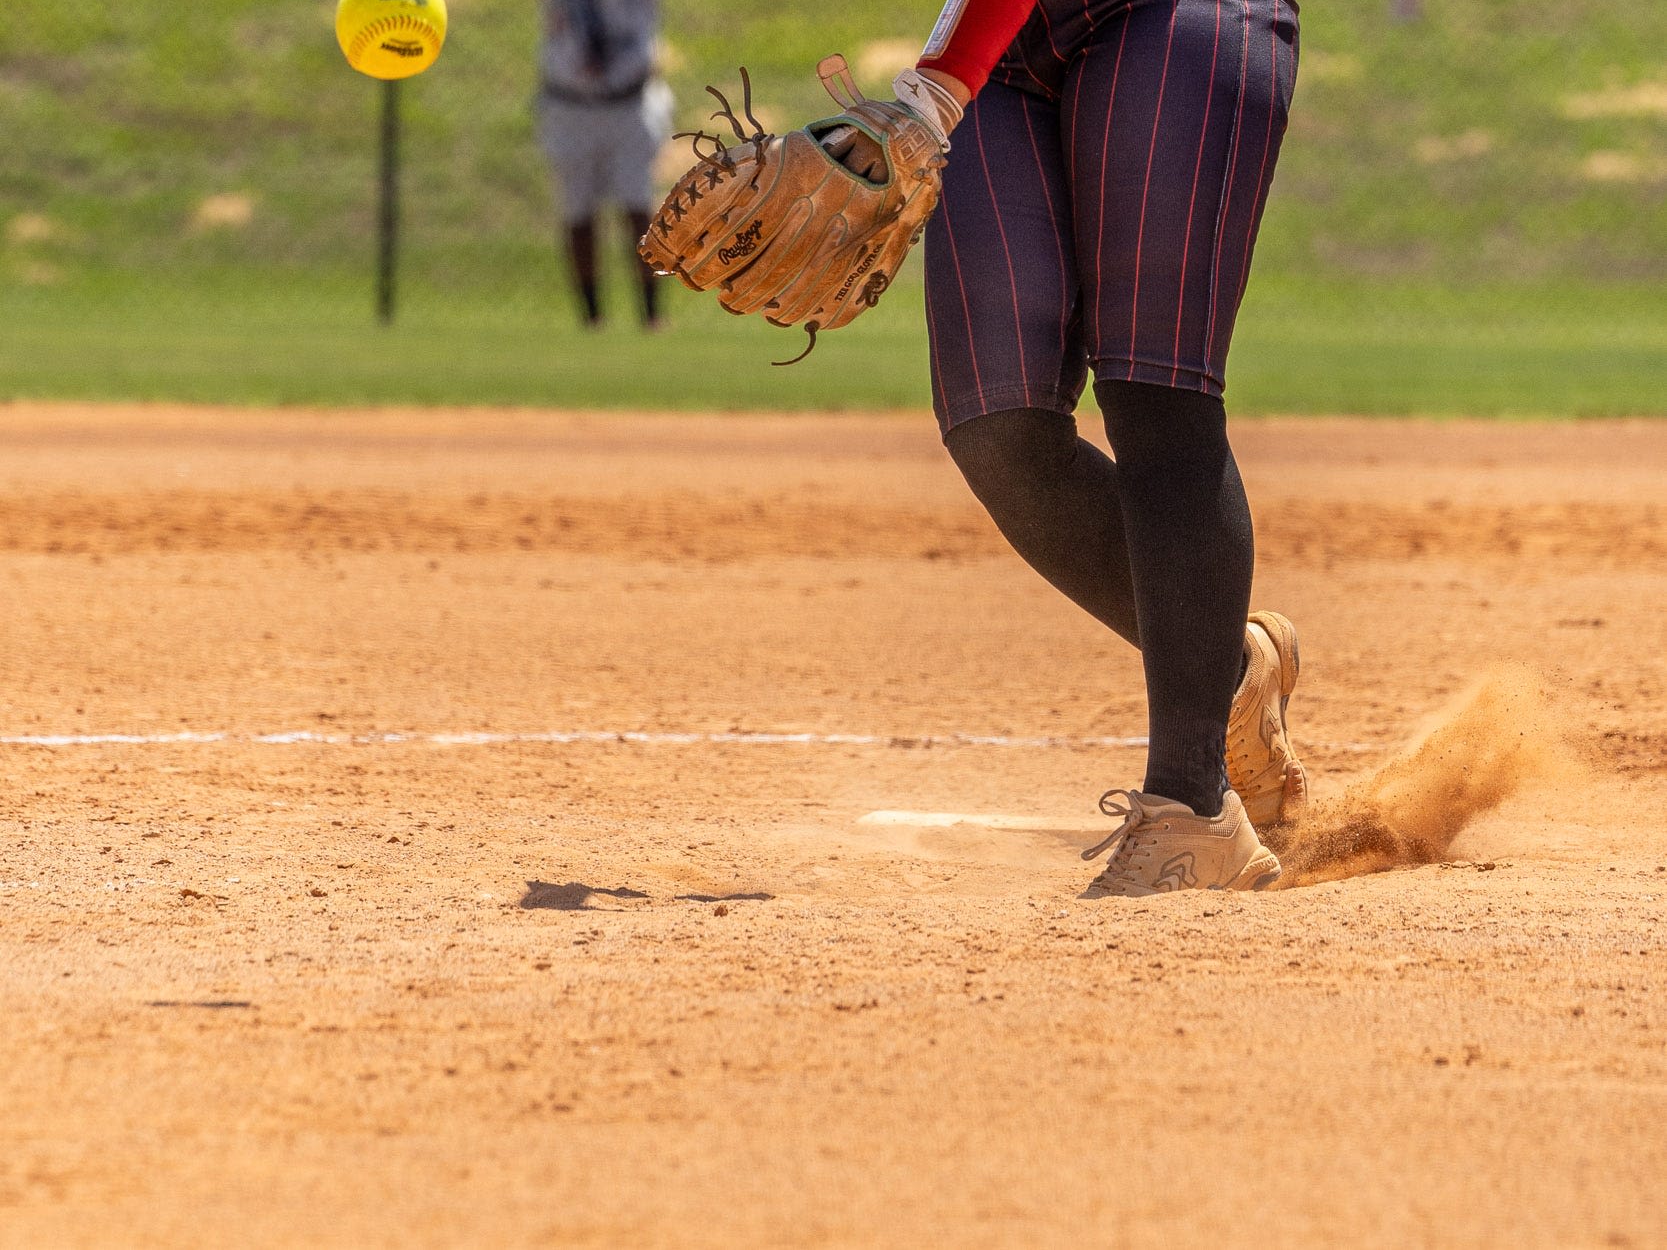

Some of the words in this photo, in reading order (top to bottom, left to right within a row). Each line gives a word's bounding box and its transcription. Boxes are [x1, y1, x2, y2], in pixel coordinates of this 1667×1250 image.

[718, 219, 764, 266] Rawlings
[834, 287, 848, 301] THE
[857, 253, 877, 274] GLOVE
